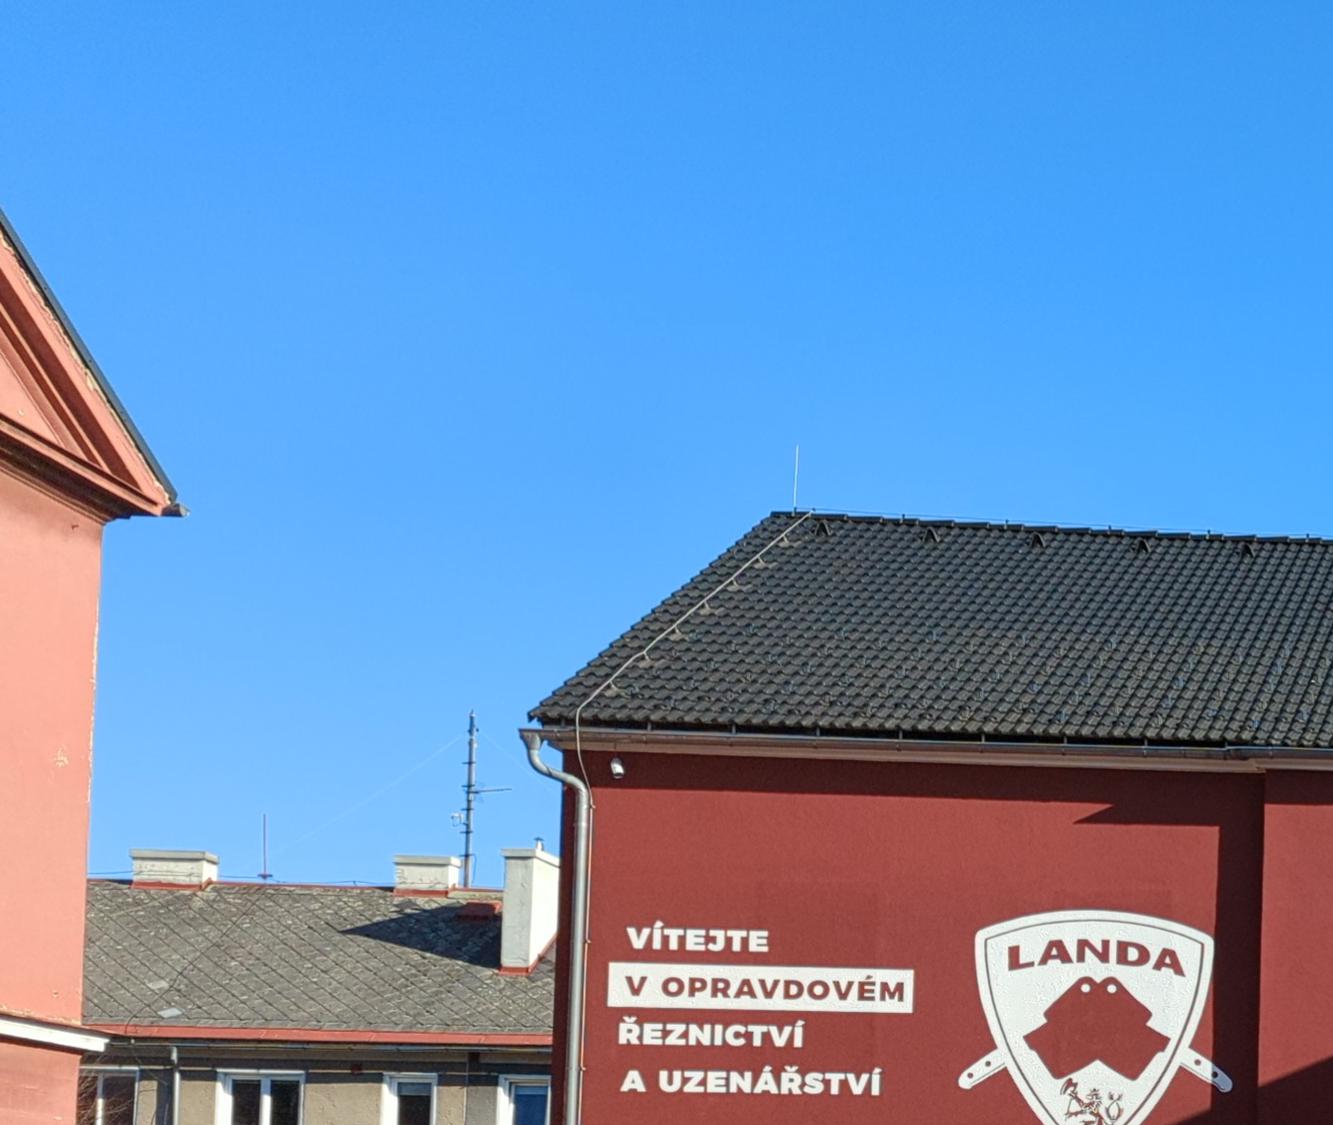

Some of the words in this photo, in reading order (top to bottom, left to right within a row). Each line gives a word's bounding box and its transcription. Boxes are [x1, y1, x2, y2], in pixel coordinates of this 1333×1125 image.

[627, 920, 768, 952] VÍTEJTE
[1009, 940, 1185, 976] LANDA
[626, 977, 646, 996] V
[661, 974, 904, 1001] OPRAVDOVÉM
[619, 1018, 805, 1048] ŘEZNICTVÍ
[620, 1070, 646, 1093] A
[659, 1066, 883, 1096] UZENÁŘSTVÍ
